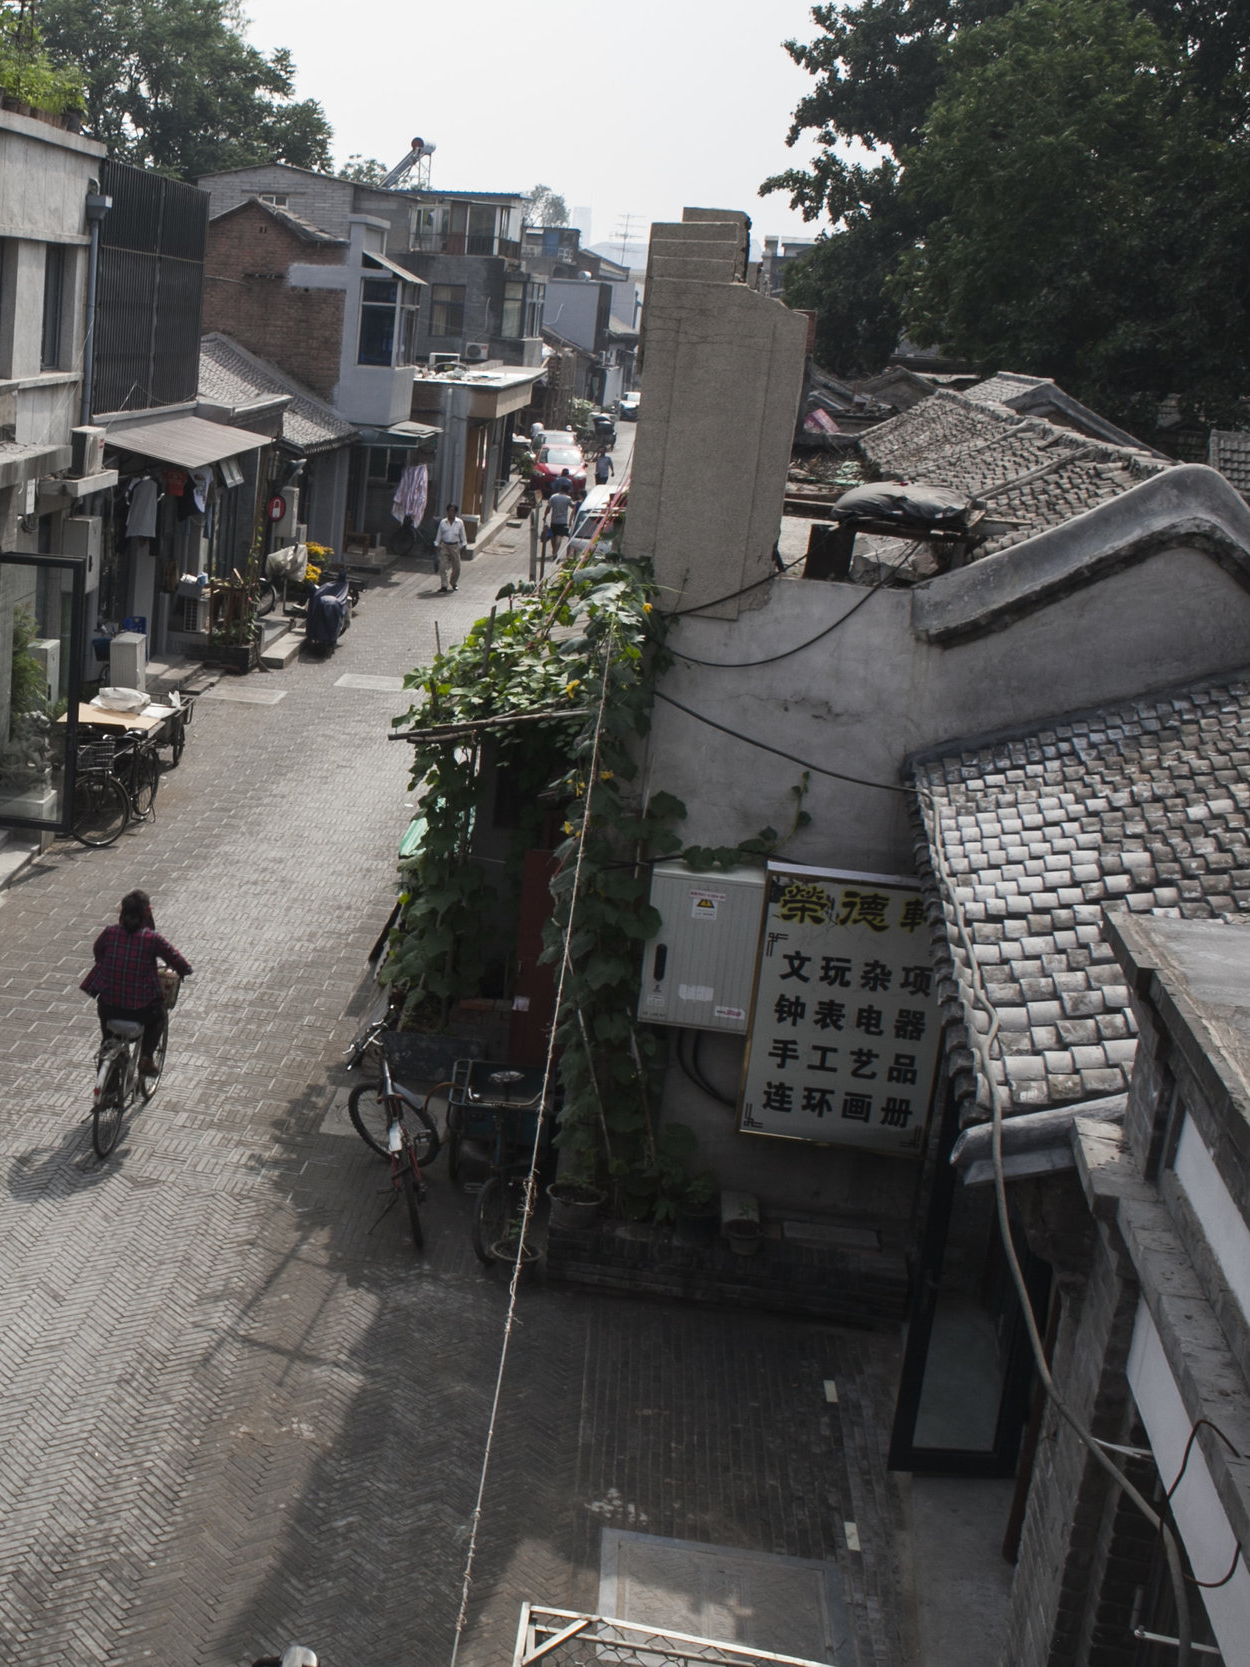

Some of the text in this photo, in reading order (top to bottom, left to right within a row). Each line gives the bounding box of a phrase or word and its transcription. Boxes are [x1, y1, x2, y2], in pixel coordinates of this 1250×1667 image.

[779, 950, 934, 998] 文玩杂项
[773, 993, 927, 1041] 钟表电器
[768, 1038, 918, 1086] 手工艺品
[762, 1081, 914, 1129] 连环画册
